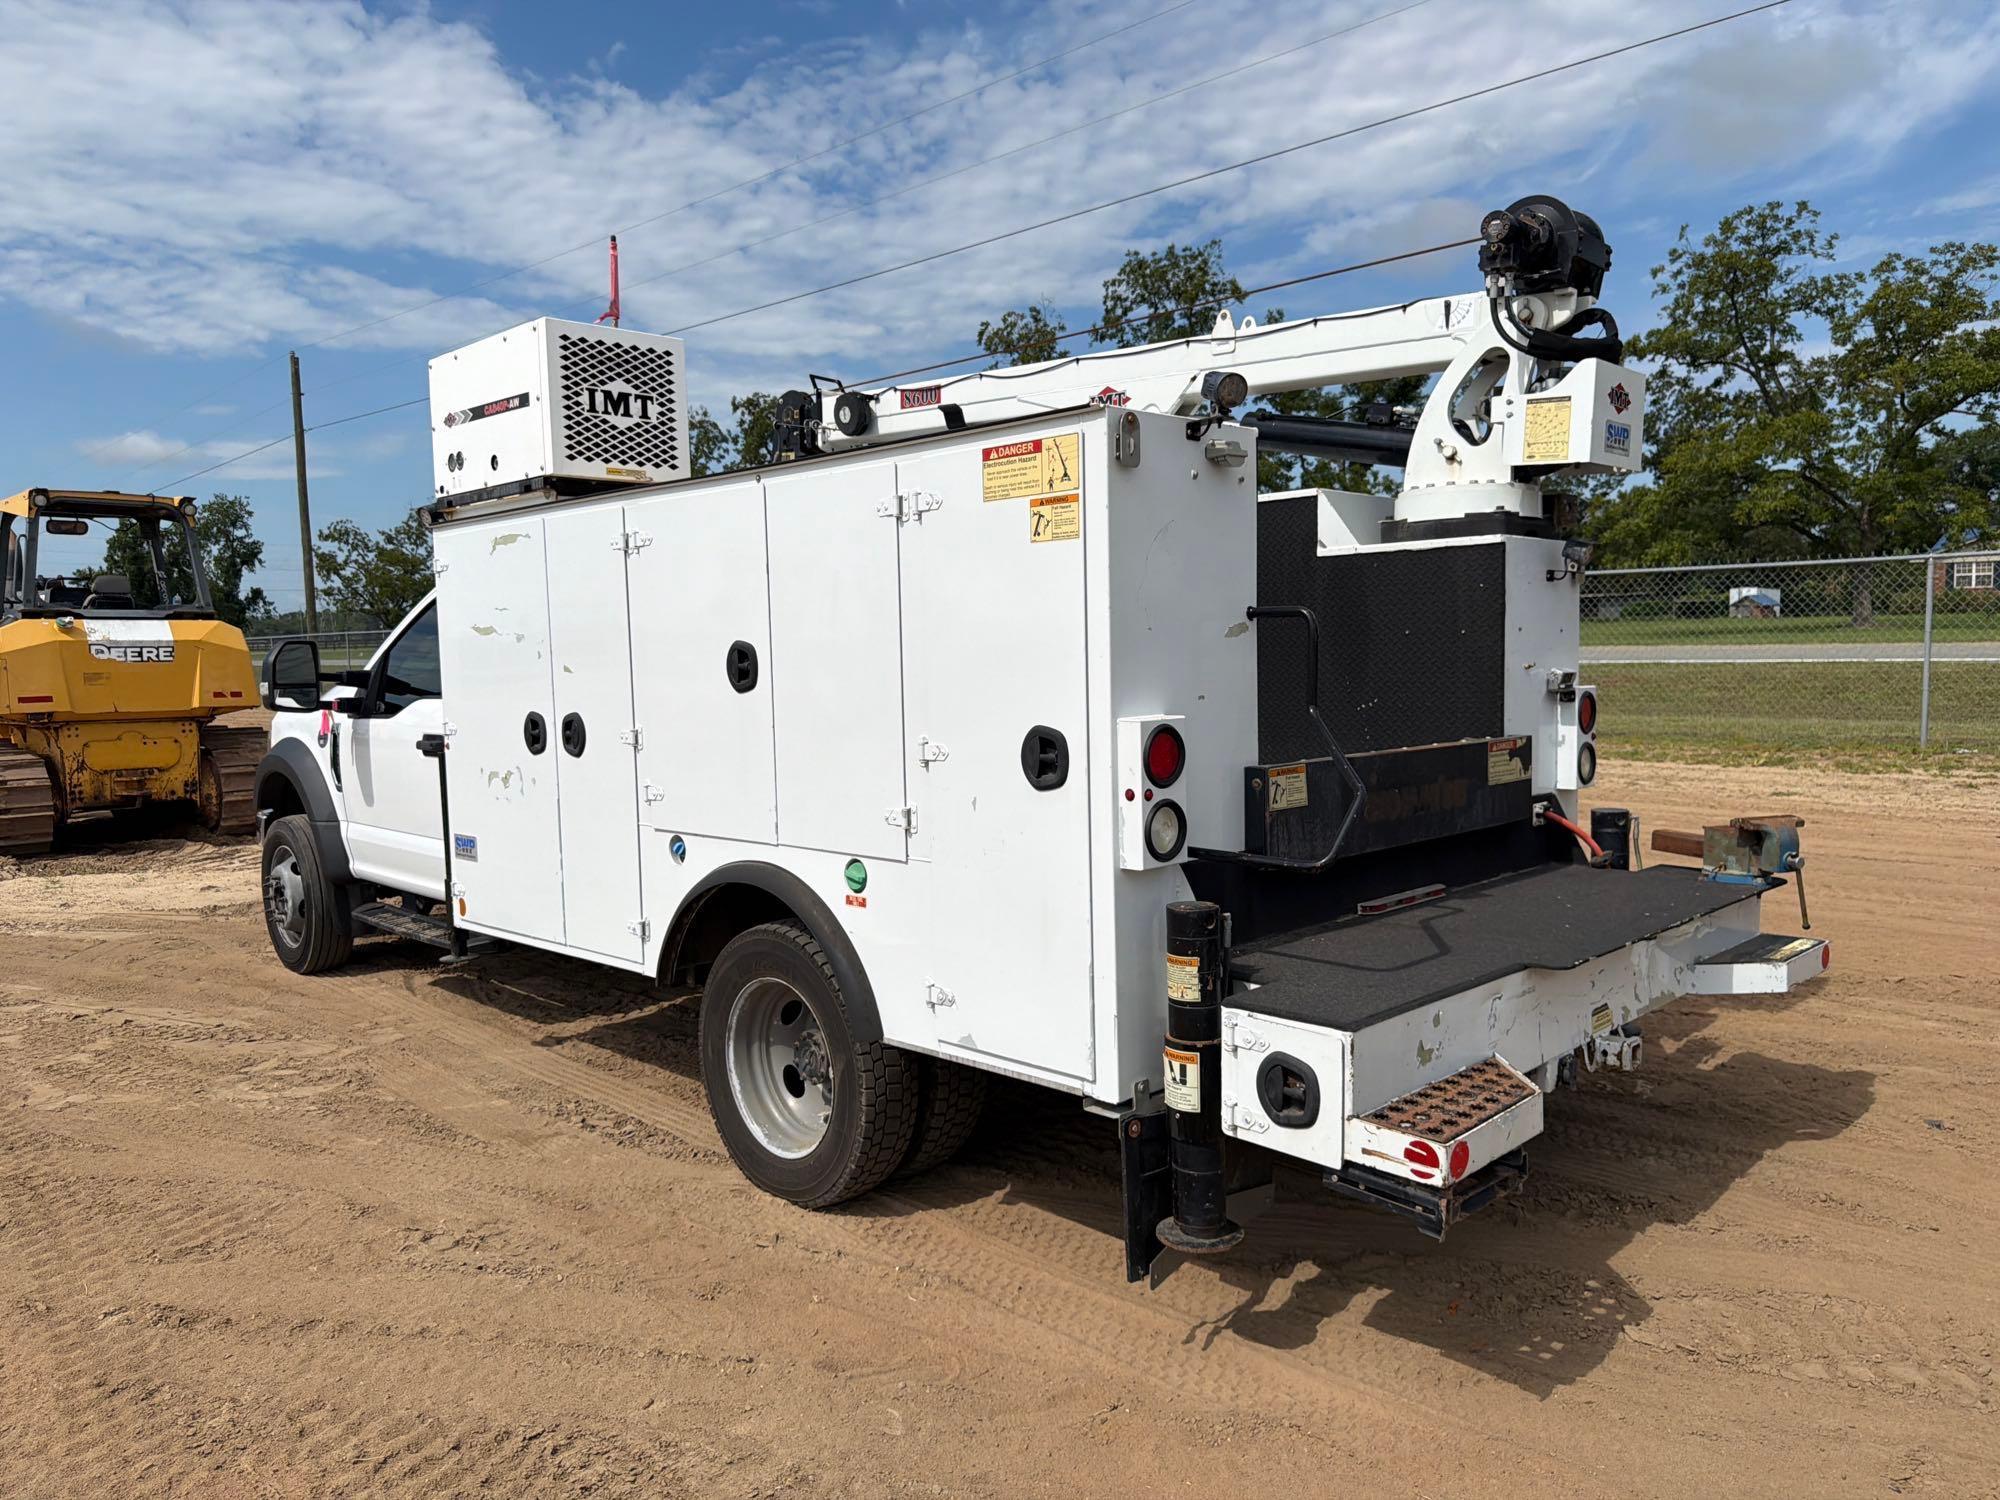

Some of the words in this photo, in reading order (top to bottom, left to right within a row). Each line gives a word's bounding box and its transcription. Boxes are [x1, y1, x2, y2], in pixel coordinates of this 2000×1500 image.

[585, 387, 654, 420] IMT
[1089, 391, 1127, 408] IMT
[1609, 386, 1630, 411] IMT
[998, 443, 1034, 457] DANGER
[984, 458, 1017, 469] Electrocution
[1018, 455, 1036, 464] Hazard
[1045, 495, 1069, 505] WARNING
[90, 644, 174, 662] DEERE
[1169, 1051, 1195, 1063] WARNING
